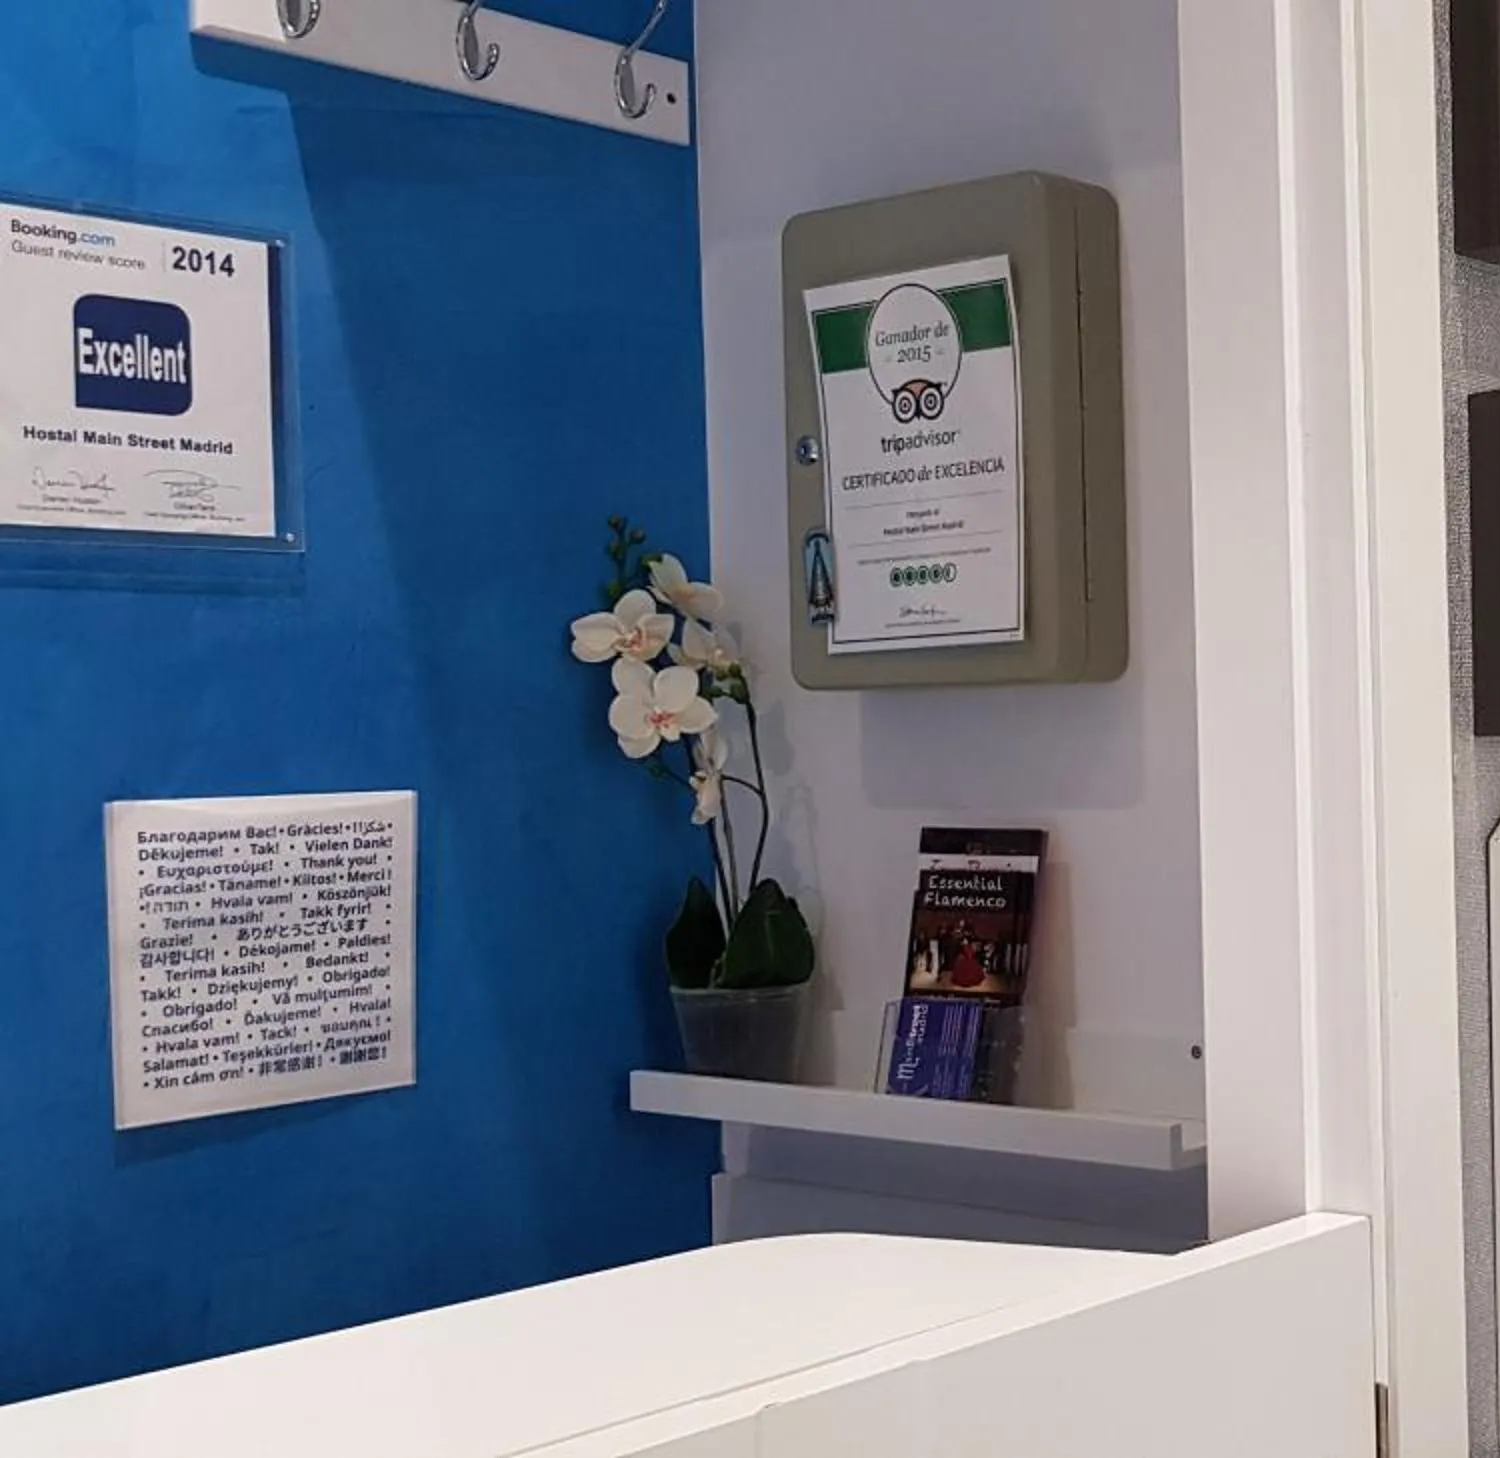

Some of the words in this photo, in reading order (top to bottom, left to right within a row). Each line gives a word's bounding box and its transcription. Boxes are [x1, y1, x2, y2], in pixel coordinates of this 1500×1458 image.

[11, 219, 116, 247] Booking.com
[11, 240, 54, 257] Guest
[58, 248, 104, 264] review
[107, 255, 146, 270] score
[172, 246, 235, 277] 2014
[875, 325, 931, 347] Ganador
[934, 320, 950, 337] de
[77, 327, 188, 384] Excellent
[897, 345, 932, 363] 2015
[23, 426, 78, 444] Hostal
[84, 430, 123, 448] Main
[127, 434, 176, 452] Street
[180, 438, 233, 455] Madrid
[881, 431, 957, 456] tripadvisor
[843, 467, 917, 491] CERTIFICADO
[917, 465, 933, 482] de
[935, 457, 1005, 480] EXCELENCIA
[137, 829, 241, 845] Благодарим
[246, 824, 277, 839] Вас!
[249, 841, 279, 856] Tak!
[305, 839, 349, 853] Vielen
[353, 836, 392, 850] Dank!
[300, 854, 344, 869] Thank
[348, 853, 377, 870] you!
[929, 875, 1003, 891] Essential
[211, 896, 253, 909] Hvala
[258, 892, 293, 906] vam!
[924, 890, 1007, 909] Flamenco
[163, 916, 215, 930] Terima
[219, 911, 264, 926] kasih!
[300, 905, 333, 920] Takk
[140, 933, 193, 950] Grazie!
[236, 918, 368, 941] ありがとうございます
[338, 934, 391, 949] Paldies!
[165, 967, 217, 982] Terima
[221, 961, 265, 977] kasih!
[305, 951, 369, 969] Bedankt!
[140, 986, 182, 1003] Takk!
[323, 965, 391, 984] Obrigado!
[142, 1017, 214, 1038] Спасибо!
[349, 997, 391, 1014] Hvala!
[162, 998, 238, 1018] Obrigado!
[156, 1038, 199, 1053] Hvala
[203, 1032, 240, 1048] vam!
[260, 1025, 297, 1041] Tack!
[143, 1054, 210, 1073] Salamat!
[154, 1076, 179, 1089] Xin
